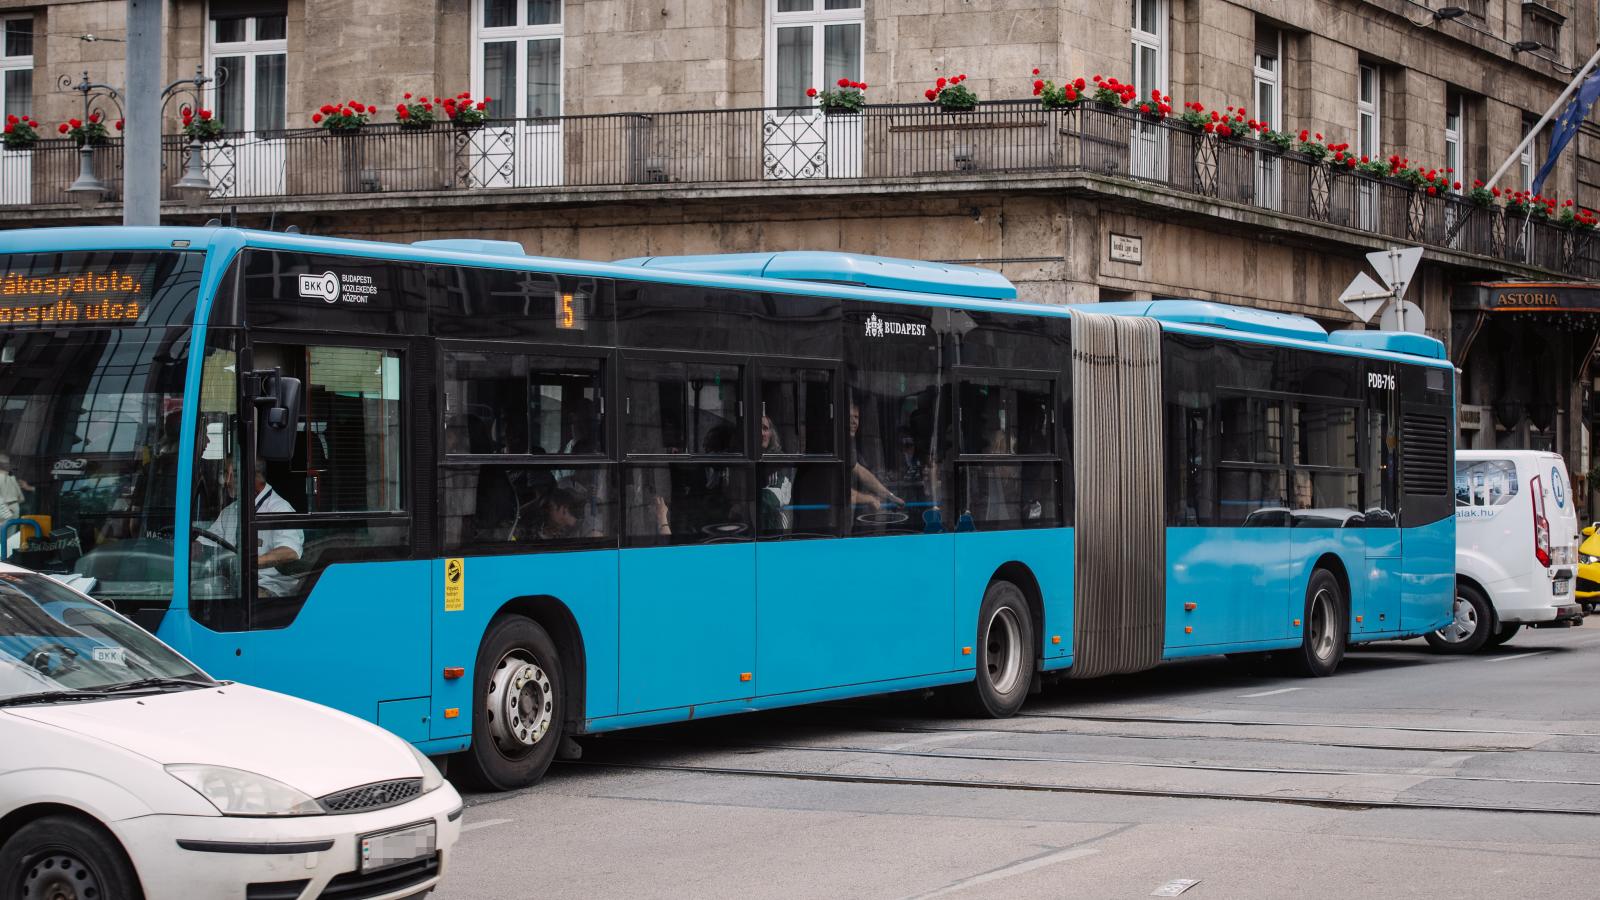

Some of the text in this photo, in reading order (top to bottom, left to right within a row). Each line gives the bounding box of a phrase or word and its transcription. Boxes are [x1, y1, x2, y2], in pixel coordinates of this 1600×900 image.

[0, 270, 141, 296] ákospalota,
[304, 280, 322, 291] BKK
[341, 274, 372, 284] BUDAPESTI
[342, 292, 369, 303] KÖZPONT
[1497, 293, 1558, 305] ASTORIA
[86, 298, 138, 319] utca
[563, 295, 573, 328] 5
[884, 321, 927, 336] BUDAPEST
[1368, 372, 1396, 390] PDB-716
[98, 651, 117, 660] BKK
